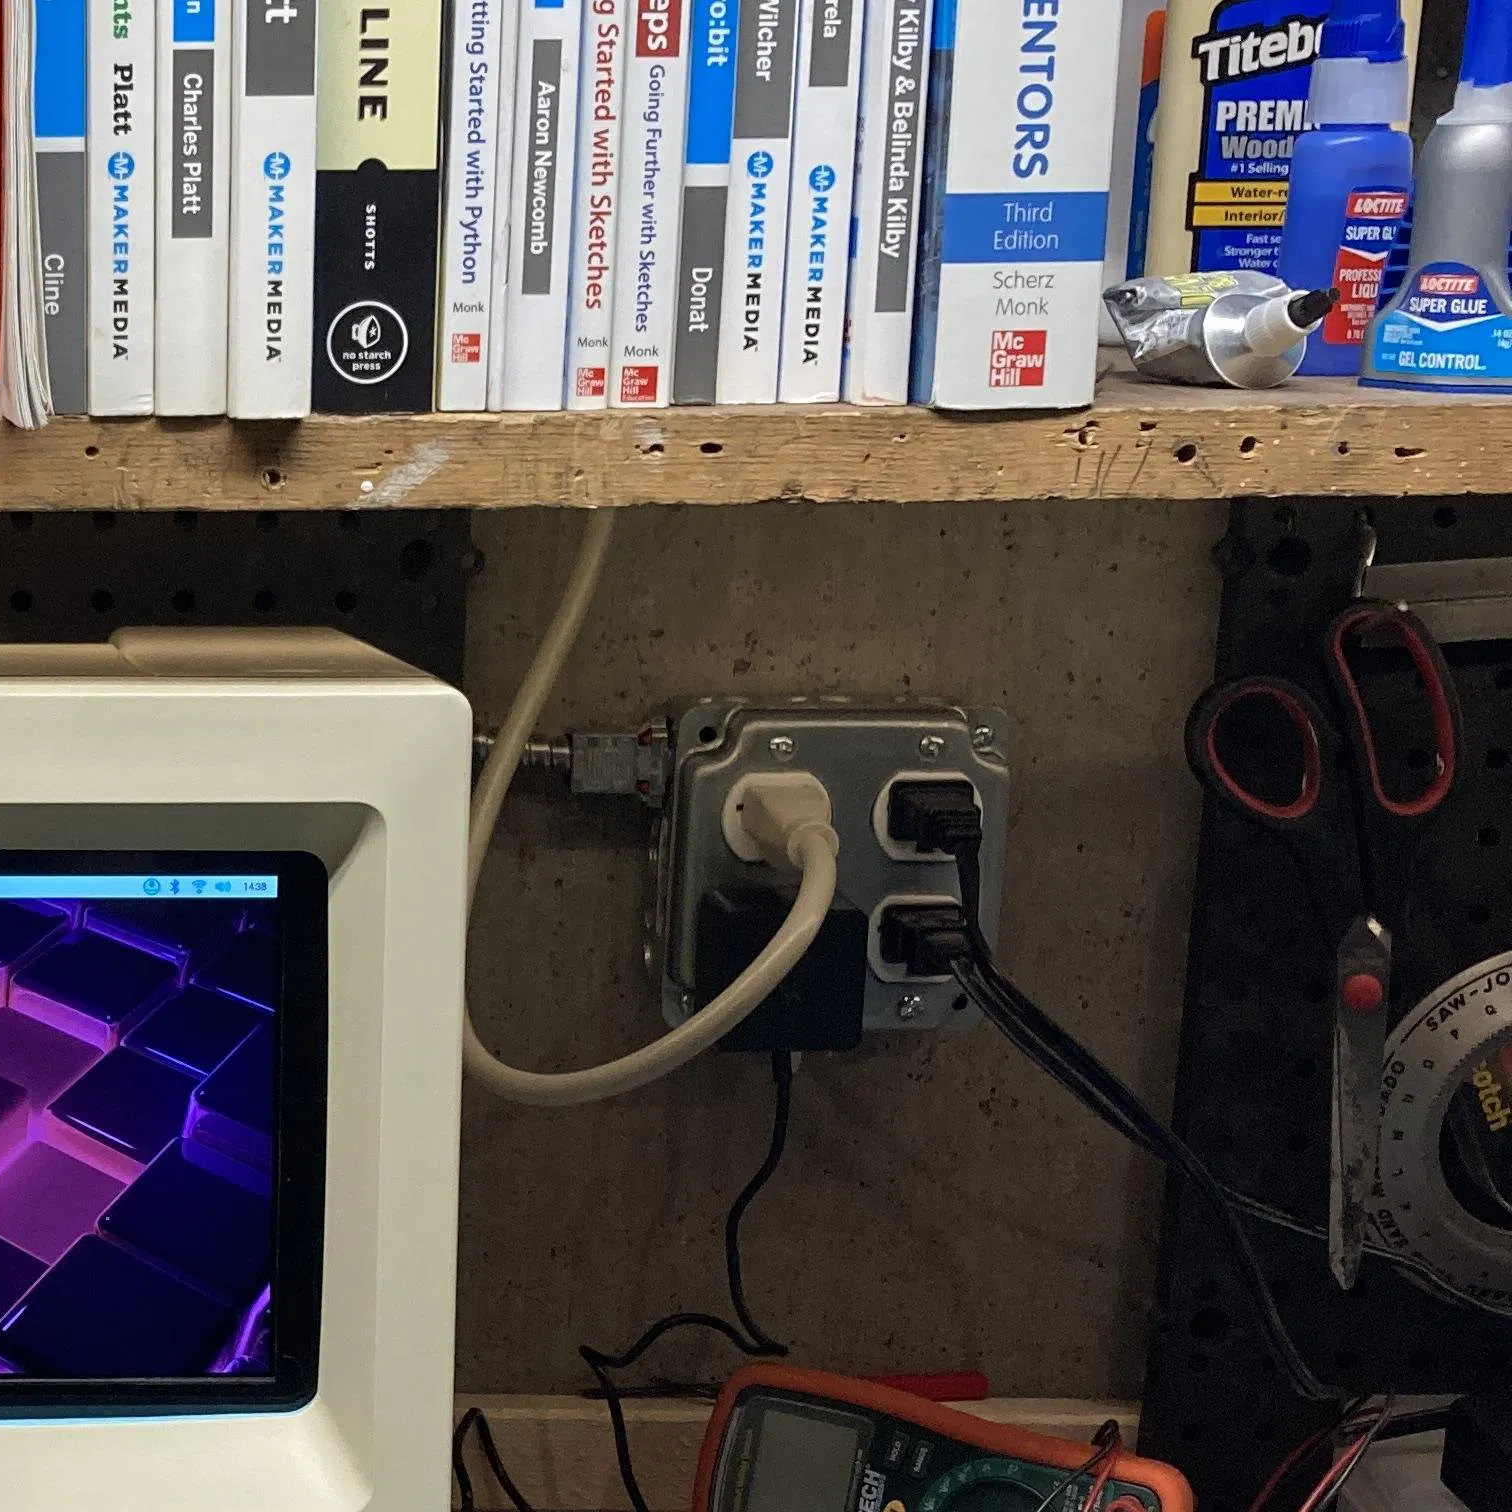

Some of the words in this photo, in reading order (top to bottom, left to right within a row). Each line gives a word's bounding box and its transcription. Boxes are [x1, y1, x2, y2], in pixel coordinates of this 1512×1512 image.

[892, 7, 920, 72] Kilby
[357, 7, 390, 122] LINE
[594, 23, 620, 121] Started
[112, 63, 135, 137] Platt
[466, 61, 488, 144] Started
[644, 64, 666, 123] Going
[894, 76, 915, 97] &
[182, 73, 204, 156] Charles
[536, 80, 556, 146] Aaron
[1215, 100, 1321, 132] PREM
[591, 129, 614, 188] with
[642, 127, 662, 201] Further
[889, 101, 916, 193] Belinda
[1221, 135, 1295, 159] Wood
[464, 149, 482, 200] with
[1248, 161, 1290, 177] Selling
[181, 162, 203, 216] Platt
[530, 151, 553, 256] Newcomb
[1354, 198, 1406, 214] LOCTITE
[640, 204, 658, 246] with
[880, 198, 908, 259] Kilby
[1003, 200, 1053, 223] Third
[364, 204, 377, 270] SHOTTS
[461, 206, 483, 285] Python
[994, 230, 1059, 251] Edition
[1224, 245, 1273, 258] Stronger
[1346, 225, 1380, 241] SUPER
[585, 194, 612, 311] Sketches
[44, 253, 65, 316] Cline
[635, 250, 656, 333] Sketches
[993, 270, 1055, 290] Scherz
[1420, 277, 1476, 292] LOCTITE
[452, 301, 485, 313] Monk
[688, 267, 713, 333] Donat
[995, 298, 1049, 317] Monk
[1409, 297, 1446, 313] SUPER
[1450, 299, 1488, 314] GLUE
[342, 351, 356, 360] no
[358, 350, 392, 361] starch
[577, 336, 609, 348] Monk
[624, 345, 659, 358] Monk
[992, 351, 1043, 369] Graw
[993, 334, 1025, 351] Mc
[1398, 350, 1416, 368] GEL
[1418, 352, 1484, 371] CONTROL
[352, 361, 381, 372] press
[991, 368, 1021, 387] Hill
